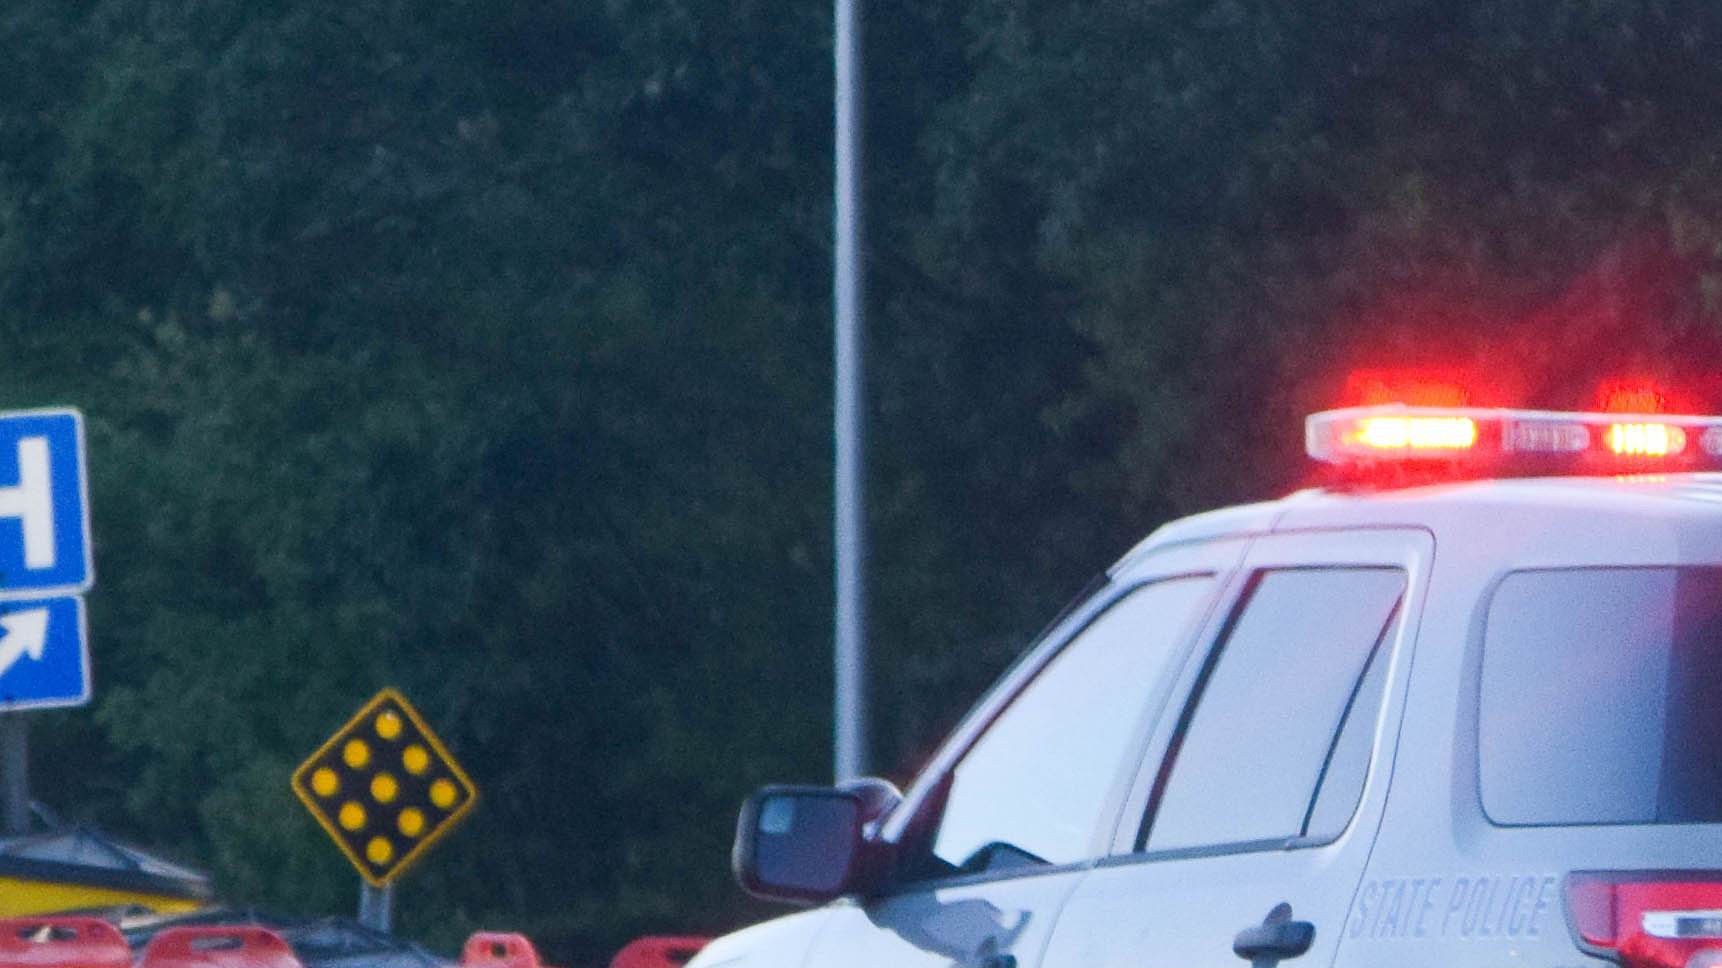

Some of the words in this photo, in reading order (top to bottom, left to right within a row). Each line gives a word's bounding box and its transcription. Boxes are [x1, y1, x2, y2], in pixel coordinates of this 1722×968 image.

[0, 436, 56, 570] H
[1350, 878, 1441, 939] STATE
[1442, 875, 1556, 938] POLICE
